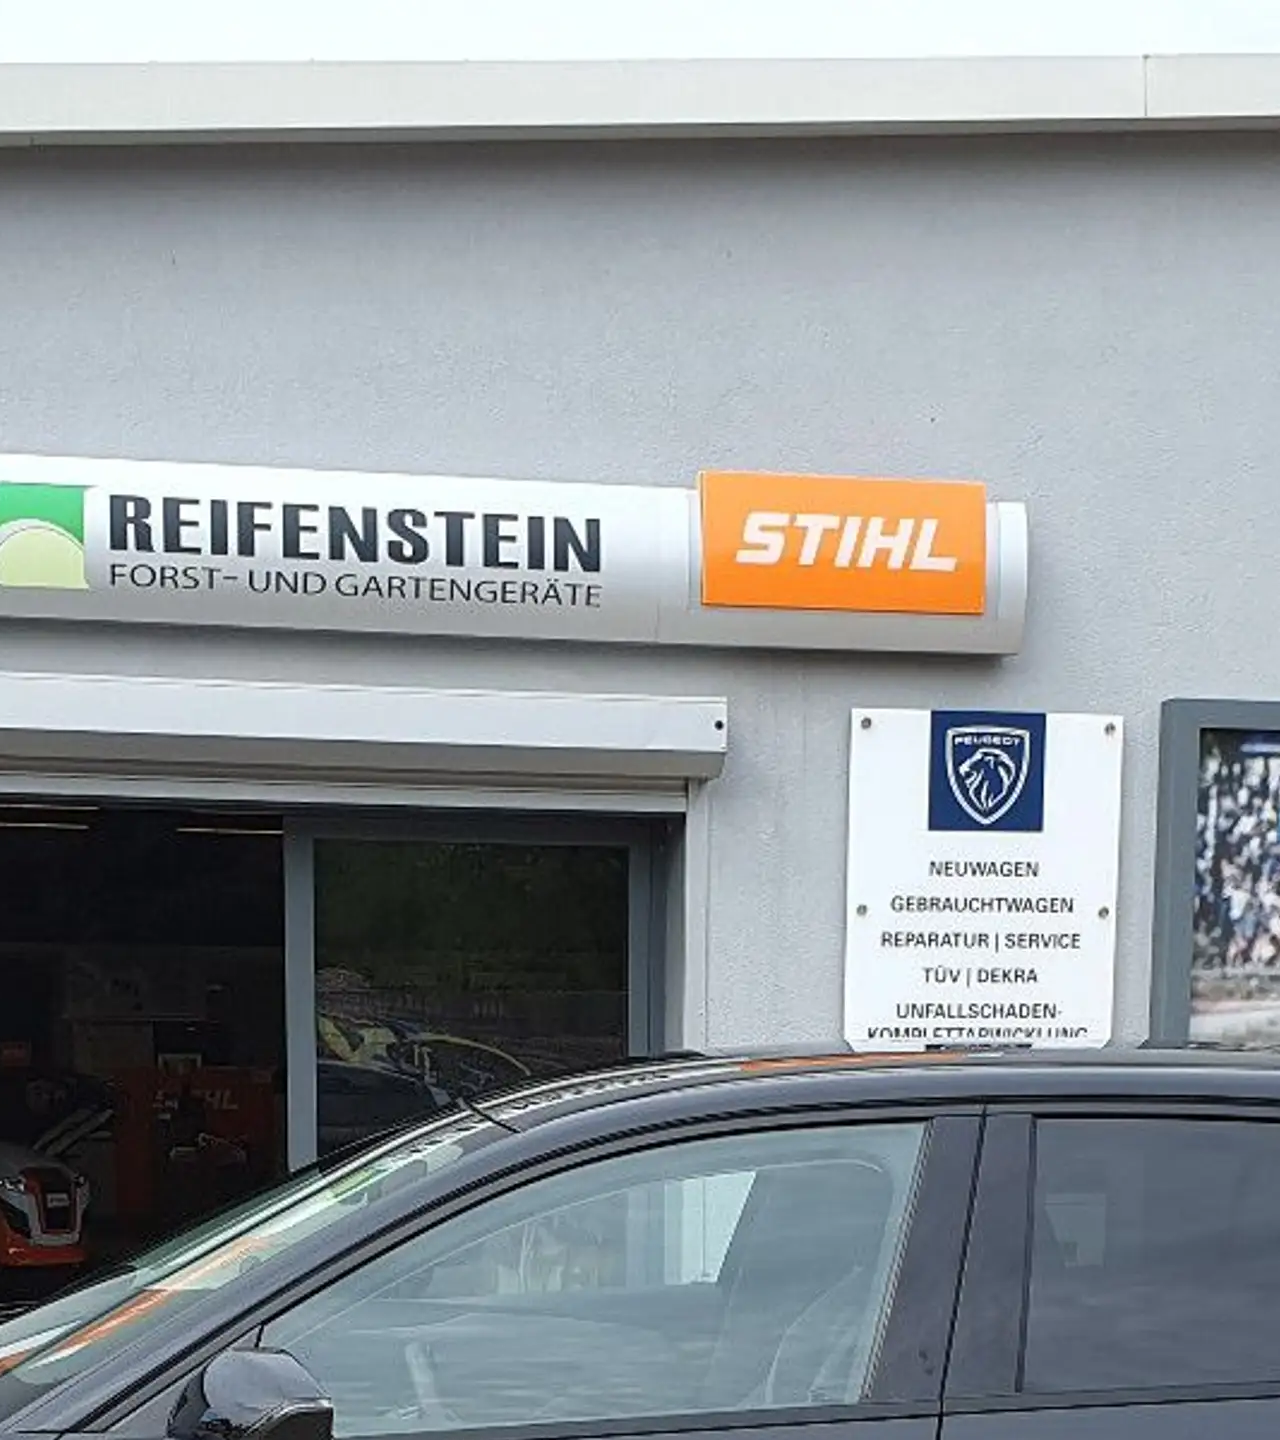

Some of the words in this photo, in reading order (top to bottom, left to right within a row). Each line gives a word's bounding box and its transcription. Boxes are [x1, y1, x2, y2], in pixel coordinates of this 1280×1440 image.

[109, 494, 601, 573] REIFENSTEIN
[735, 512, 957, 572] STIHL
[108, 563, 238, 590] FORST-
[248, 570, 327, 595] UND
[335, 573, 603, 608] GARTENGERÄTE
[954, 735, 1021, 747] PEUGEOT
[929, 861, 1039, 878] NEUWAGEN
[890, 896, 1074, 914] GEBRAUCHTWAGEN
[881, 931, 990, 949] REPARATUR
[1004, 933, 1081, 949] SERVICE
[924, 965, 962, 983] TÜV
[977, 968, 1038, 983] DEKRA
[896, 1003, 1063, 1019] UNFALLSCHADEN-
